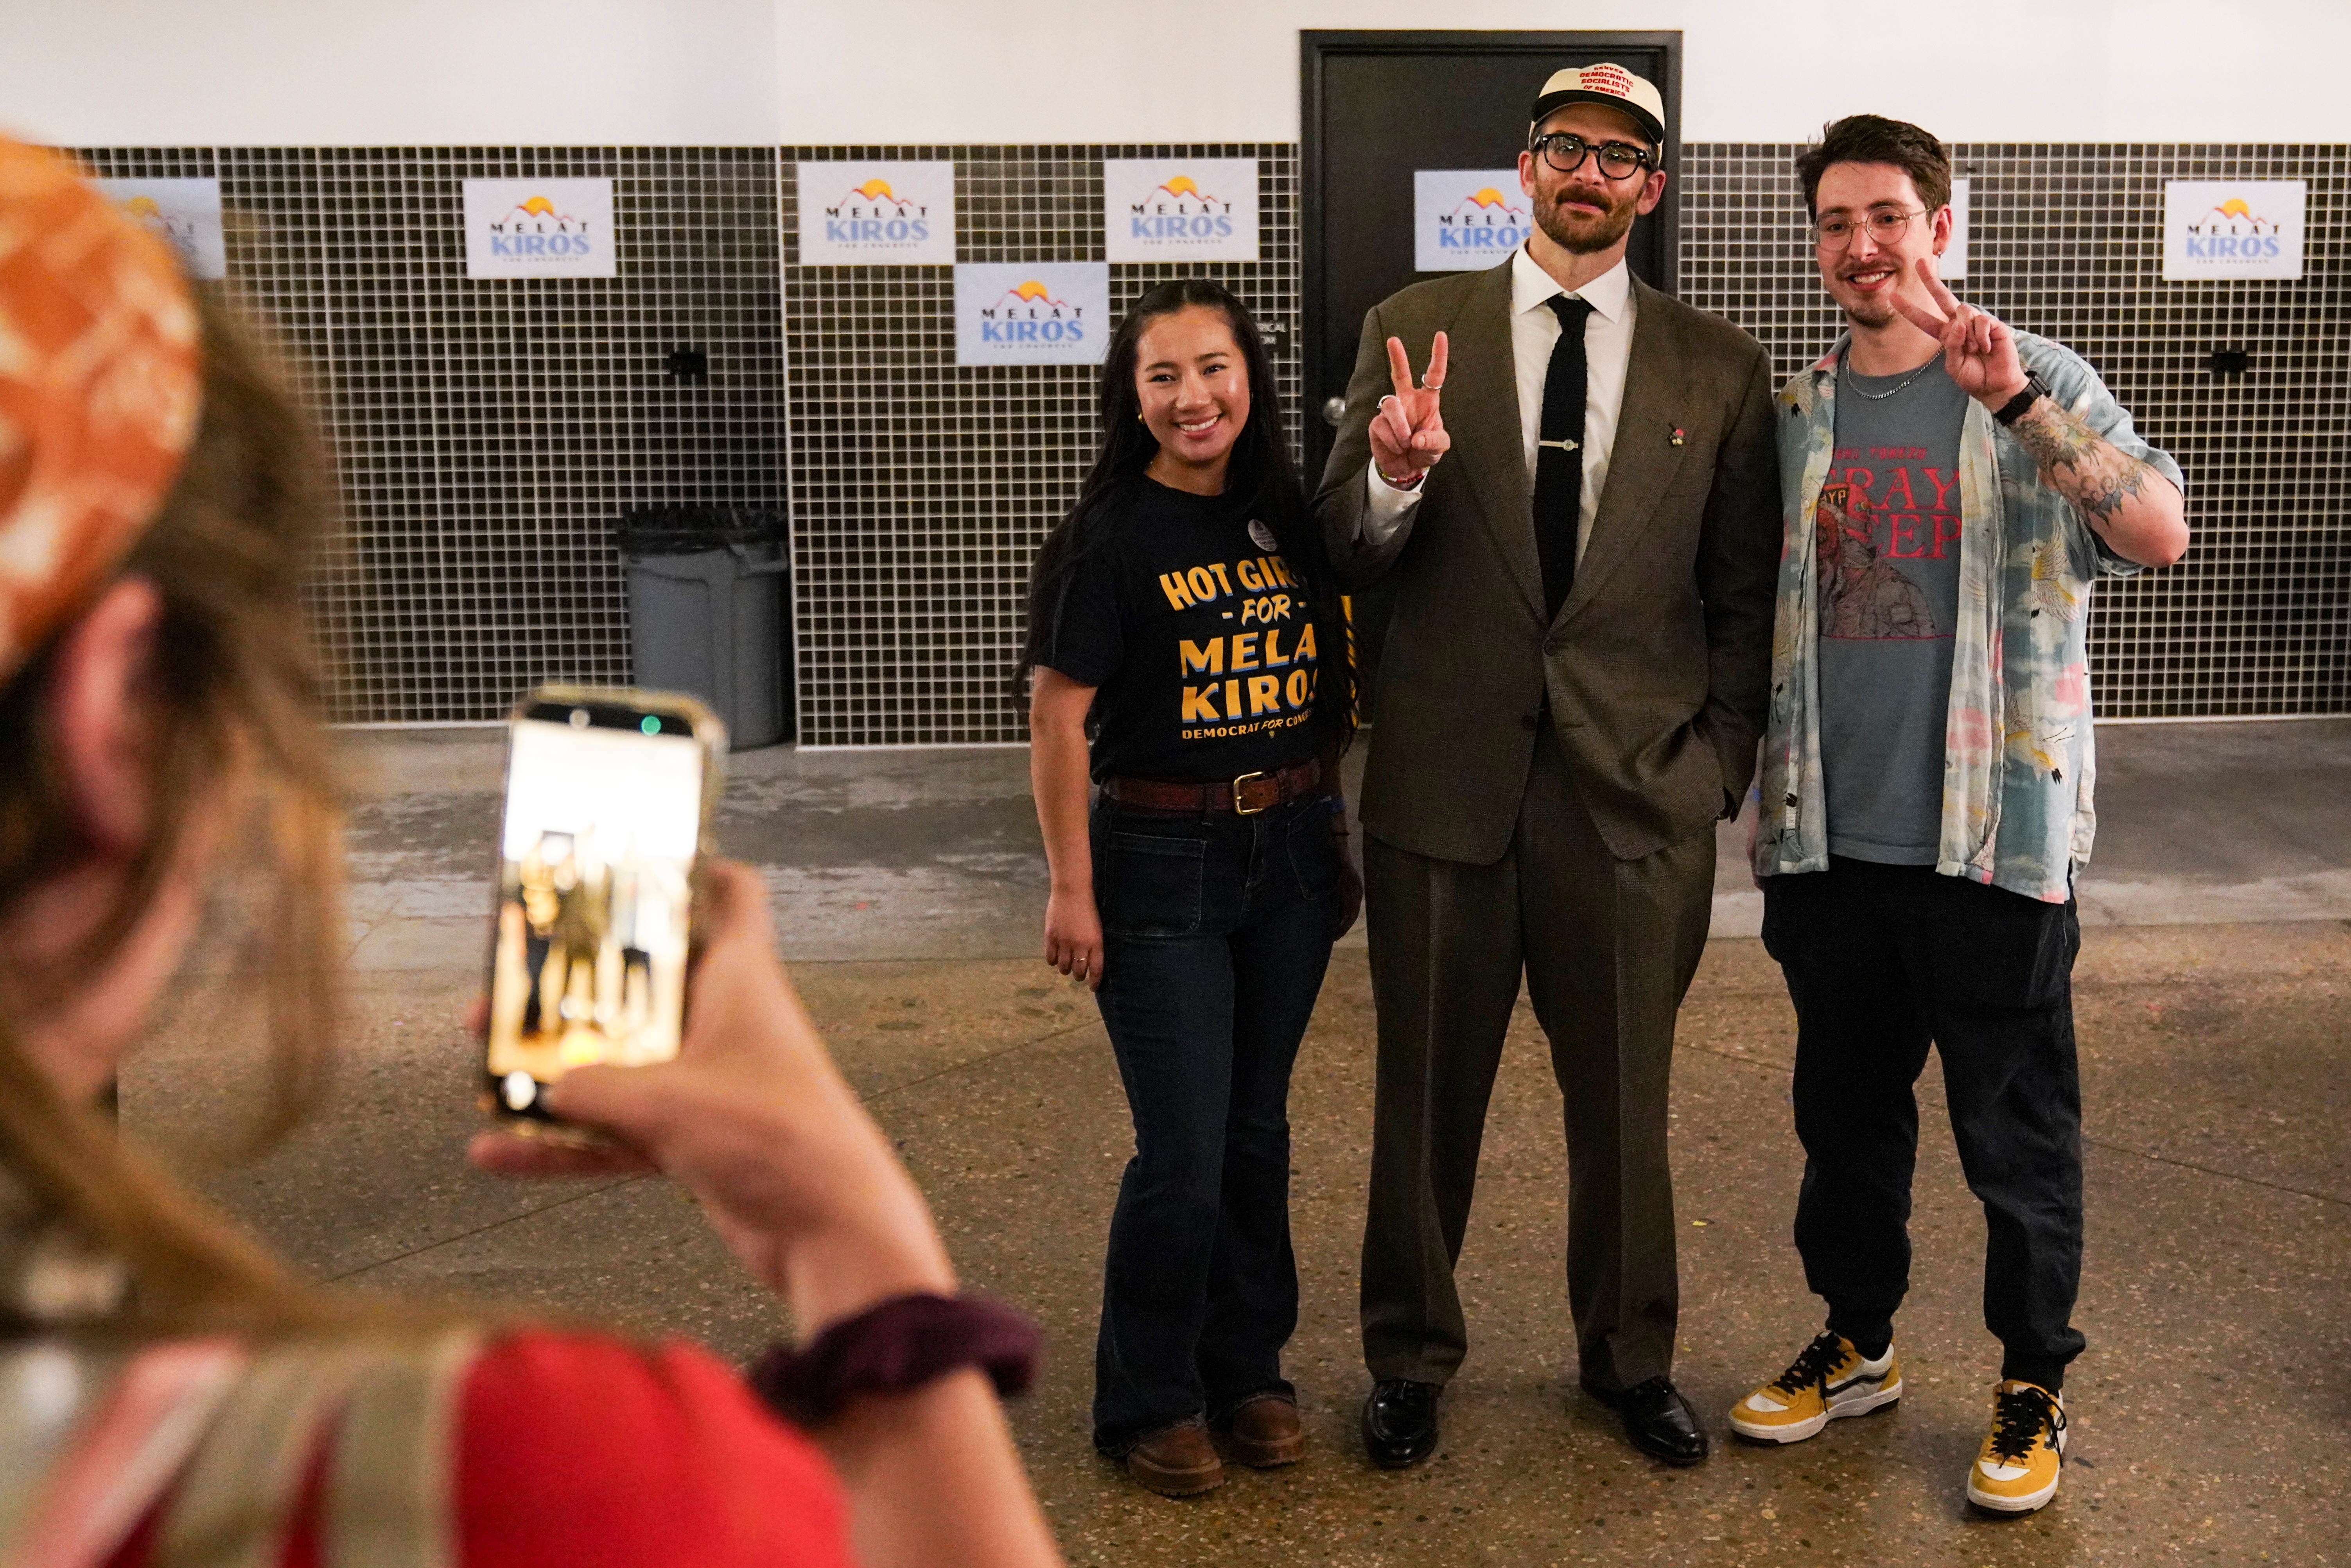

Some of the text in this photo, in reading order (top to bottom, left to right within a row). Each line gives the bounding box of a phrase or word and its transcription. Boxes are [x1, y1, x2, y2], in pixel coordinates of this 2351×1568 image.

[1594, 66, 1623, 74] DENVER
[1579, 72, 1633, 87] DEMOCRATIC
[1581, 79, 1630, 92] SOCIALISTS
[1595, 86, 1626, 97] AMERICA
[826, 207, 927, 218] MELAT
[1131, 203, 1231, 215] MELAT
[491, 222, 588, 233] MELAT
[1131, 215, 1233, 238] KIROS
[1440, 215, 1533, 226] MELA
[826, 219, 929, 242] KIROS
[2187, 224, 2280, 235] MELAT
[491, 235, 590, 256] KIROS
[2186, 237, 2279, 258] KIROS
[982, 308, 1083, 319] MELAT
[982, 321, 1084, 342] KIROS
[1829, 466, 1960, 510] RAY
[1159, 563, 1233, 611] HOT
[1241, 594, 1290, 626] FOR
[1179, 623, 1317, 679] MELA
[1182, 722, 1260, 739] DEMOCRAT
[1261, 719, 1284, 730] FOR
